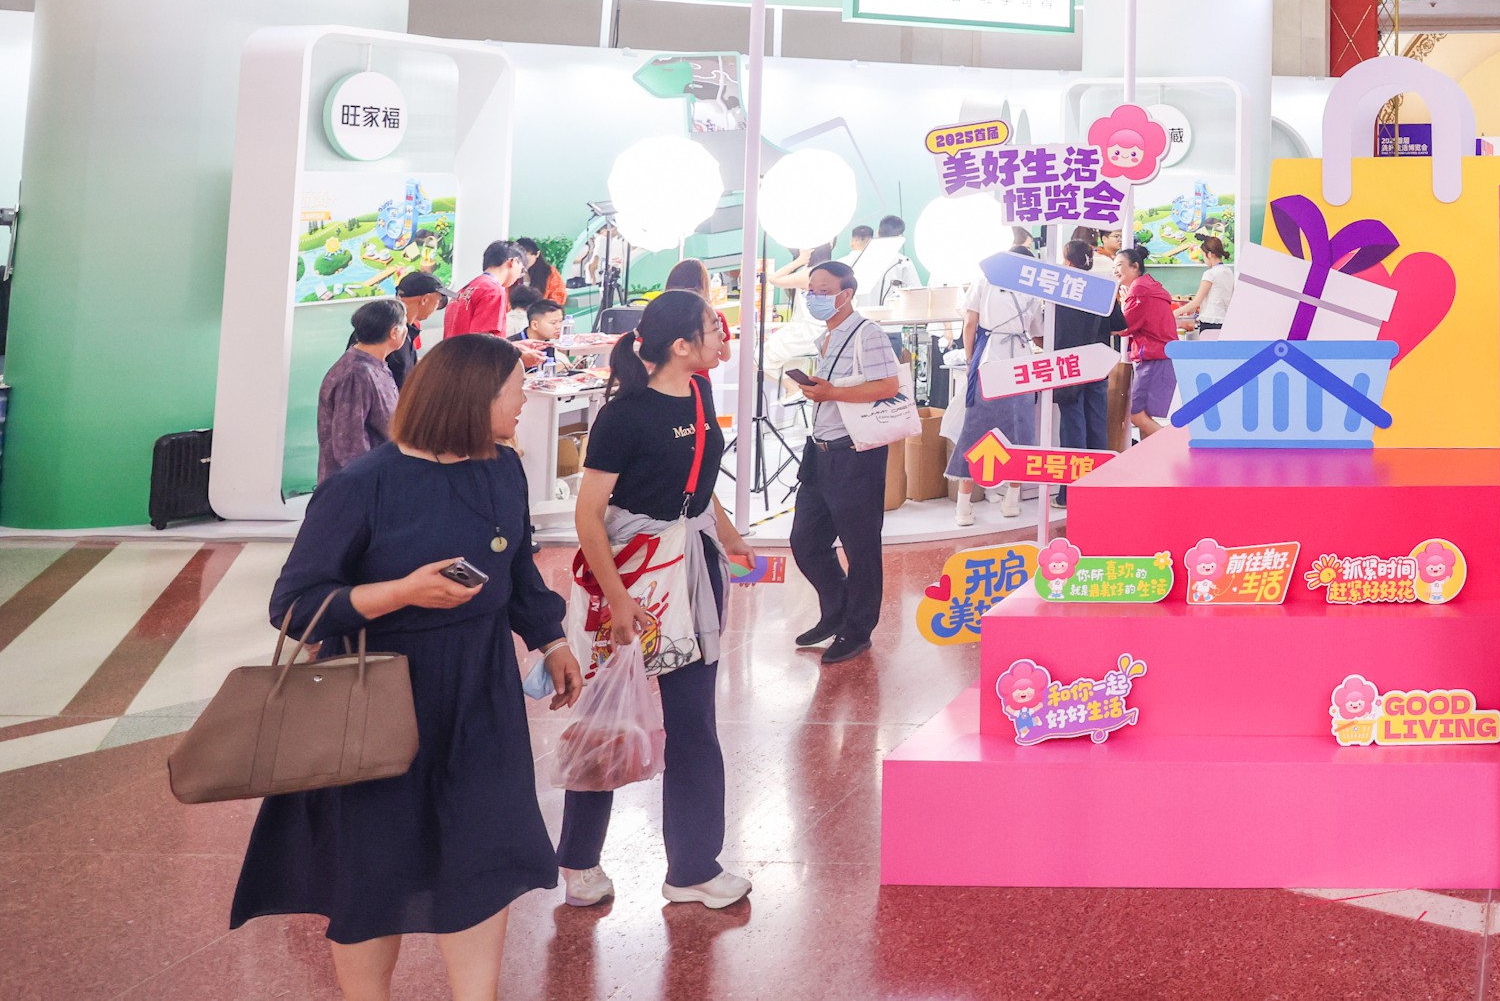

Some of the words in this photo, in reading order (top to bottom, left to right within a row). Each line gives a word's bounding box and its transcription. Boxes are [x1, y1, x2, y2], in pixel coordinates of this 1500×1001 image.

[341, 104, 401, 130] 旺家福
[936, 126, 999, 148] 2025首届
[943, 146, 1100, 195] 美好生活
[1003, 180, 1125, 224] 博览会
[1019, 265, 1087, 302] 9号馆
[1013, 353, 1081, 386] 3号馆
[672, 423, 711, 438] Maxa
[1026, 455, 1095, 480] 2号馆
[965, 550, 1028, 597] 开启
[1076, 560, 1147, 582] 你所喜欢的
[1226, 548, 1287, 574] 前往美好
[1342, 558, 1416, 581] 抓紧时间
[1070, 578, 1167, 597] 就是最美好的生活
[1238, 569, 1284, 601] 生活
[1329, 580, 1415, 601] 赶紧好好花
[1048, 674, 1128, 707] 和你一起
[1046, 696, 1123, 729] 好好生活
[1385, 695, 1471, 716] GOOD
[1384, 718, 1497, 739] LIVING
